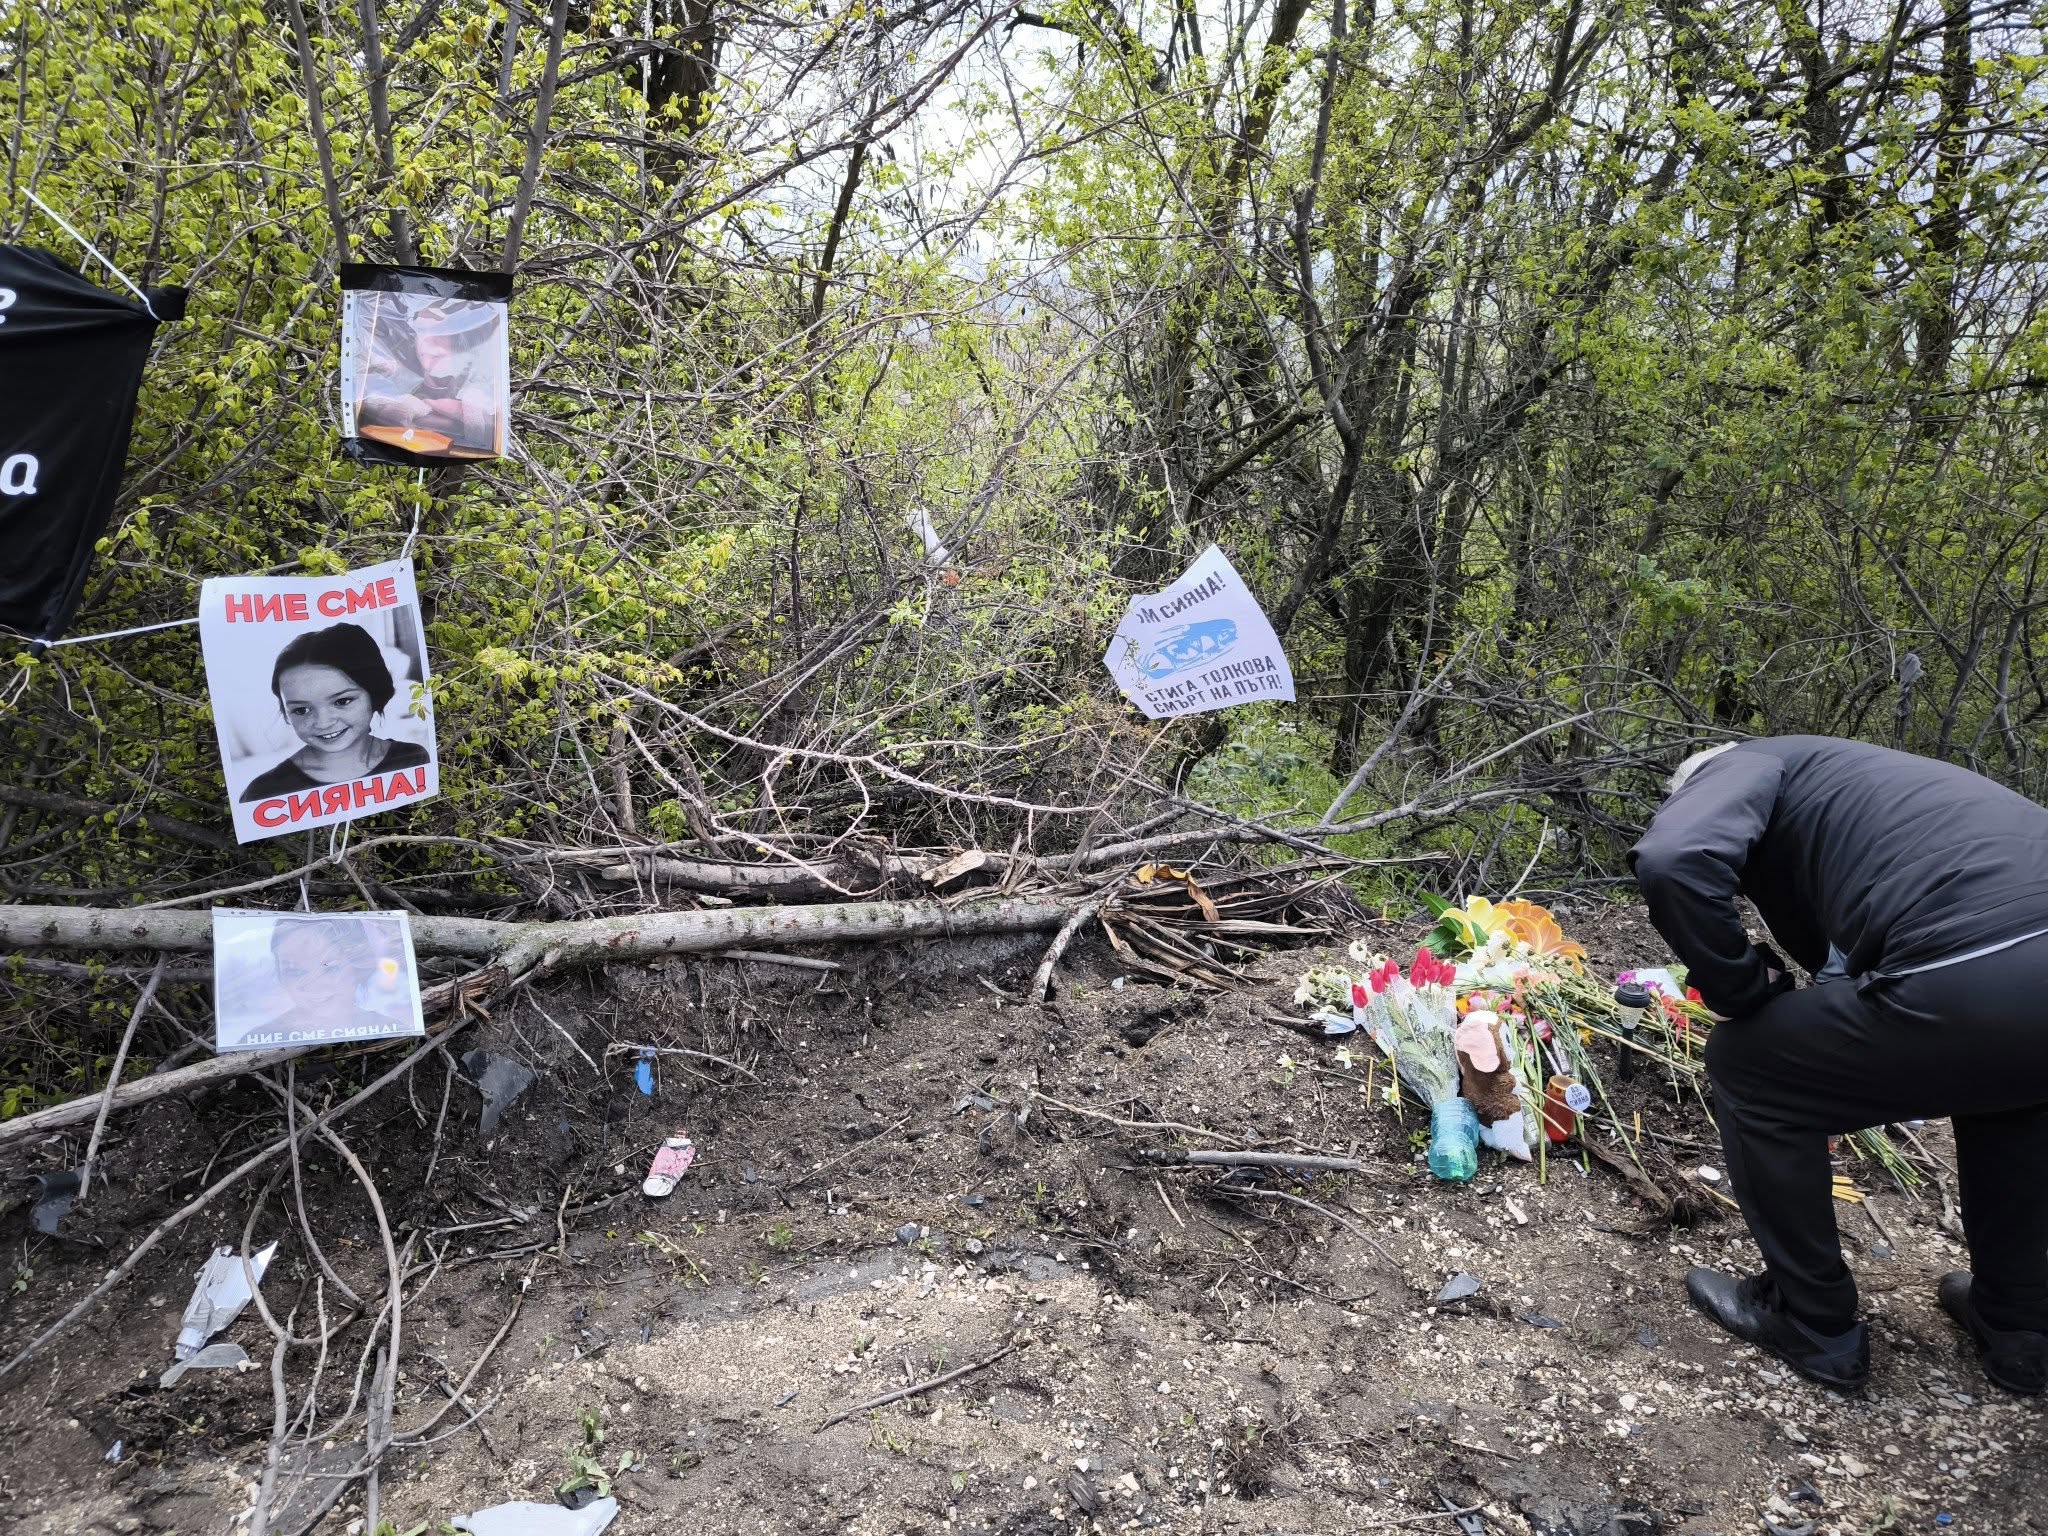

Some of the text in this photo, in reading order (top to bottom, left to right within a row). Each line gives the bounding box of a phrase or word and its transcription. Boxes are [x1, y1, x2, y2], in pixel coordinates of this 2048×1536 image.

[225, 577, 398, 623] НИЕ СМЕ
[1160, 571, 1226, 618] СИЯНА!
[1145, 655, 1277, 702] СТИГА ТОЛКОВА
[1153, 674, 1283, 714] СМЪРТ НА ПЪТЯ!
[252, 767, 427, 827] СИЯНА!
